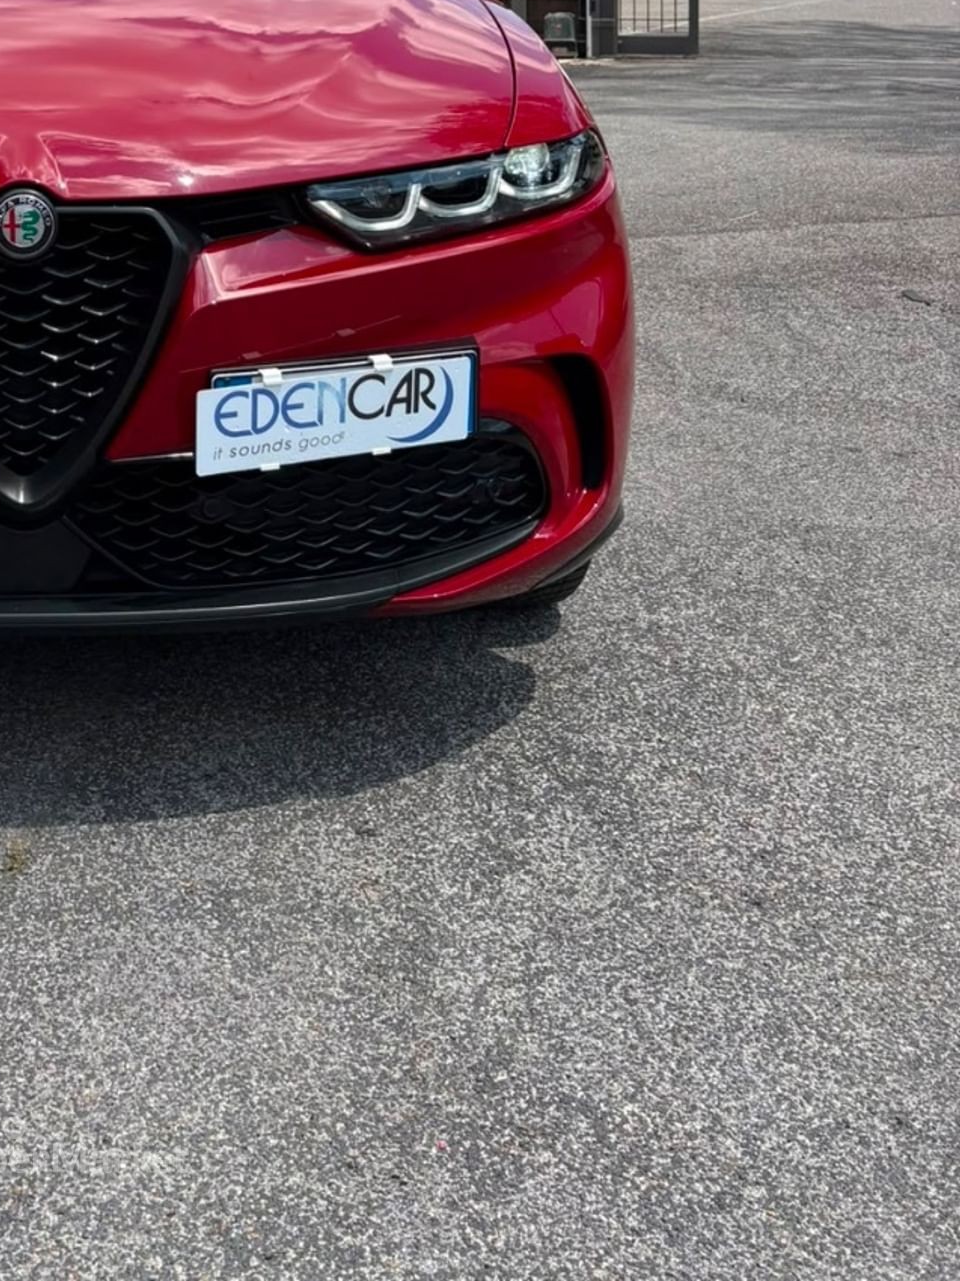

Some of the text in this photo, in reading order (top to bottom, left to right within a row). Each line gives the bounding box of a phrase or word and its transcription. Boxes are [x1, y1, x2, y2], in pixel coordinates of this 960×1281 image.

[214, 367, 437, 438] EDENCAR
[212, 446, 224, 461] it
[229, 437, 292, 457] sounds
